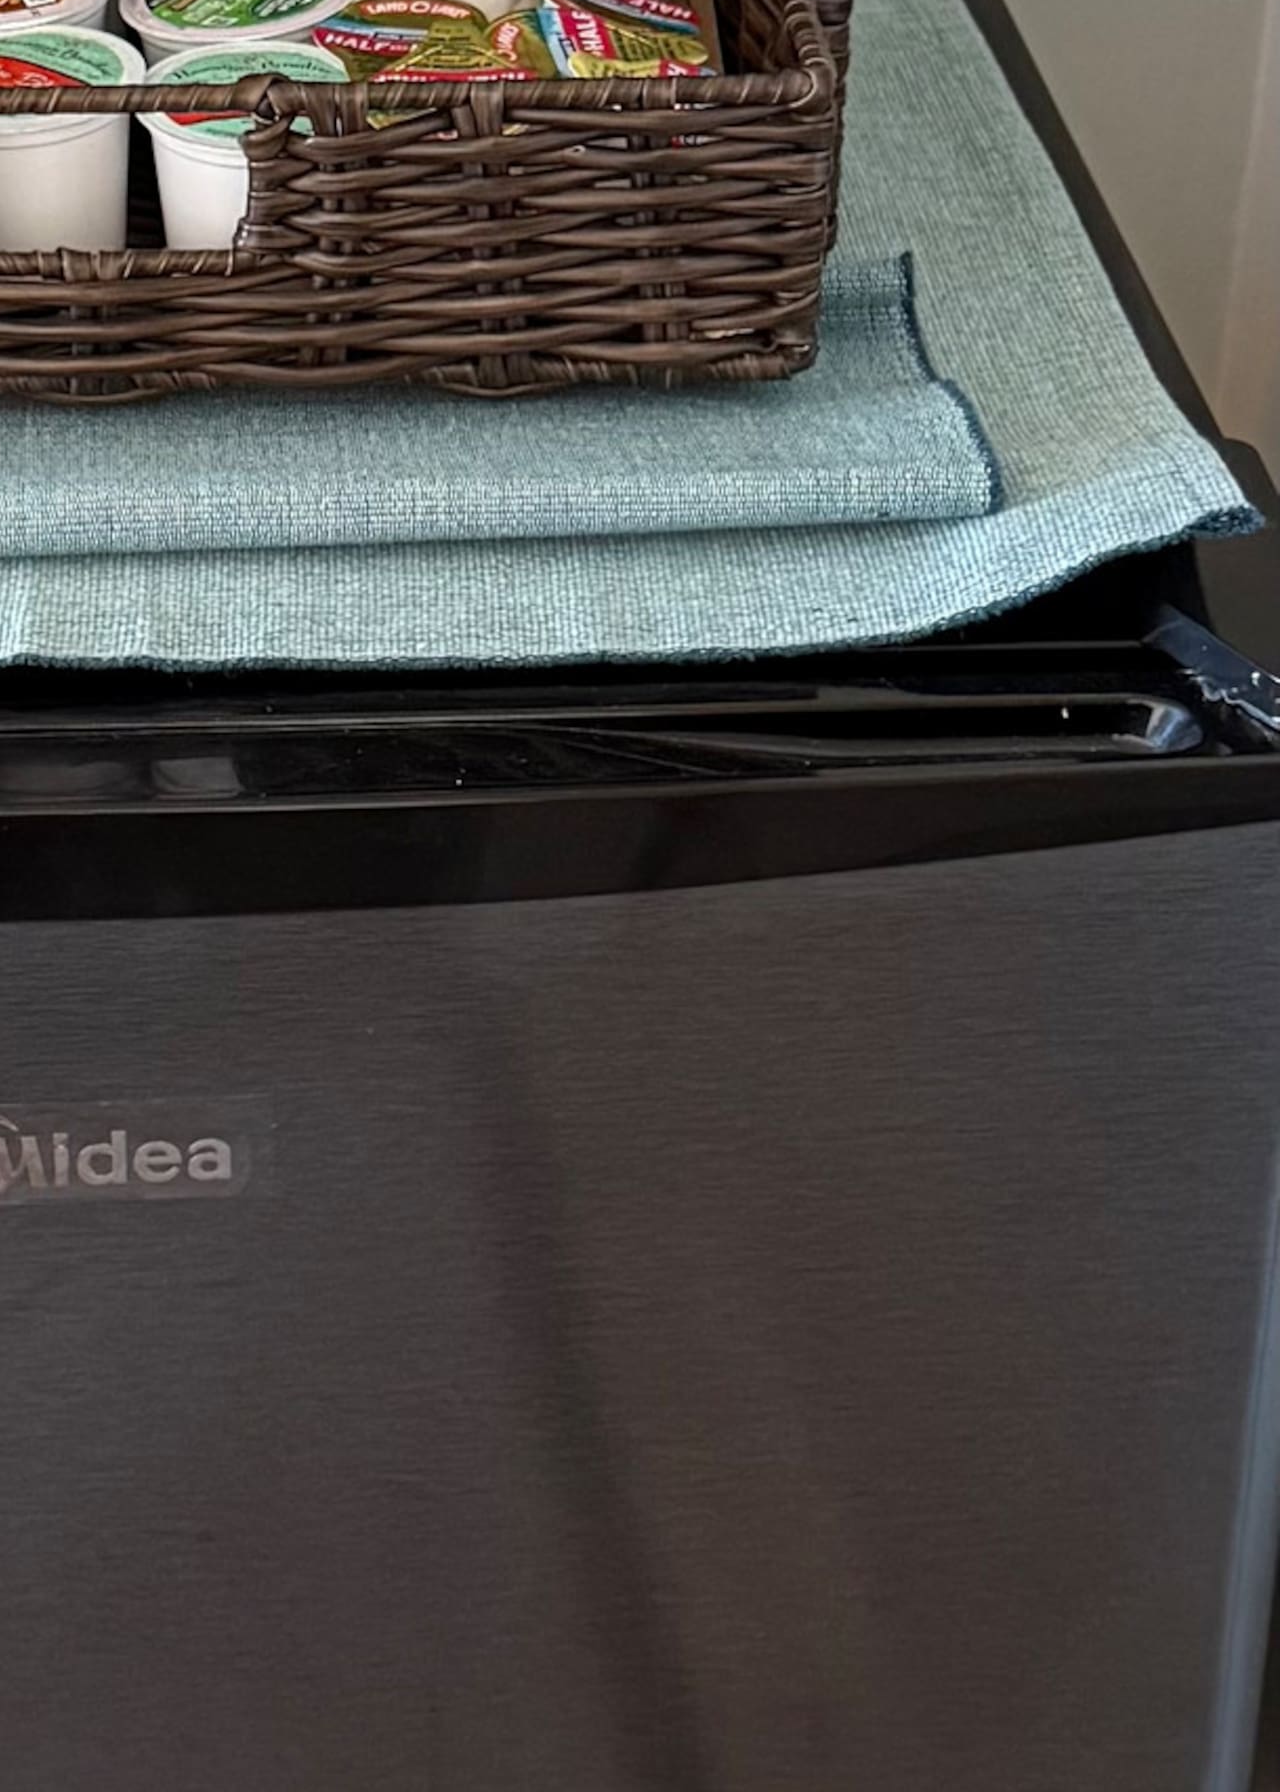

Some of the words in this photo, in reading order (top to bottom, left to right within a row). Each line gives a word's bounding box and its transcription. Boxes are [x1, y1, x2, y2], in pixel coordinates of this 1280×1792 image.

[366, 1, 408, 15] LAND
[410, 0, 431, 14] O
[323, 33, 391, 52] HALF
